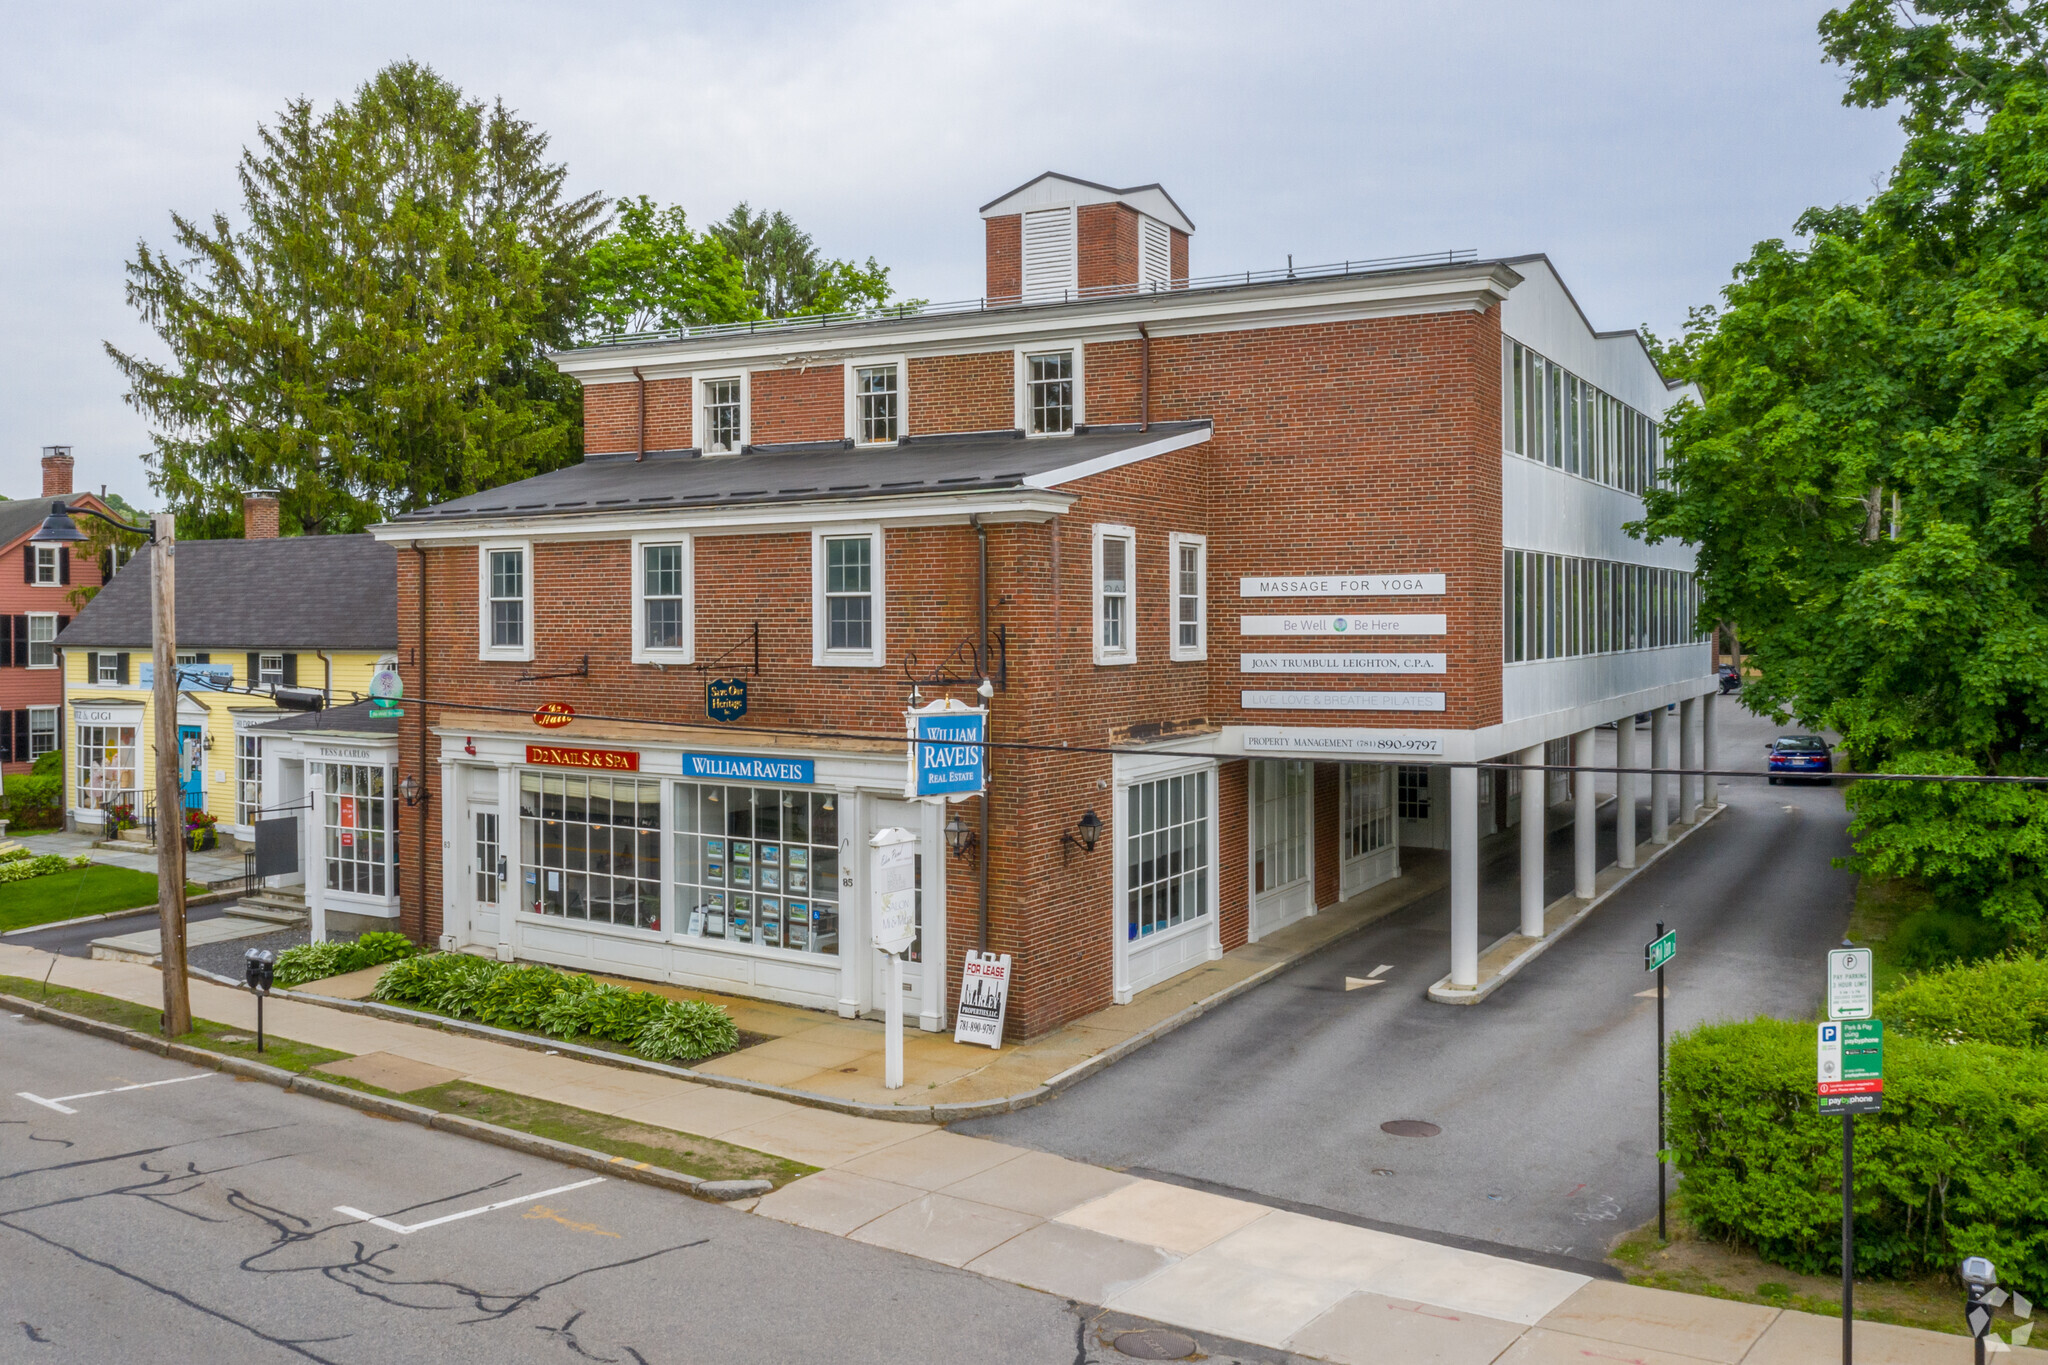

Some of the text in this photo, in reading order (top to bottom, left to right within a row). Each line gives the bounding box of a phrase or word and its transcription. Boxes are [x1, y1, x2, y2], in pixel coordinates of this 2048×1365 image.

[1260, 579, 1424, 592] MASSAGE FOR YOGA
[1284, 619, 1400, 631] Be Well Be Here
[1251, 658, 1435, 669] JOAN TRUMBULL LEIGHTON, C.P.A.
[711, 685, 744, 697] Save Our
[712, 698, 742, 710] Heritage
[1252, 694, 1433, 707] LIVE LOVE & BREATHE PILATES
[90, 711, 111, 721] GIGI
[926, 727, 977, 742] WILLIAM
[1248, 737, 1437, 751] PROPERTY MANAGEMENT (781) 890-9797
[320, 747, 370, 759] TESS & CARLOS
[532, 748, 630, 768] D2 NAILS & SPA
[924, 746, 979, 769] RAVEIS
[692, 757, 803, 780] WILLIAM RAVEIS
[928, 771, 974, 784] REAL ESTATE
[843, 878, 853, 887] 85
[967, 963, 1005, 978] FOR LEASE
[960, 1020, 996, 1036] 781-890-9797
[1844, 1037, 1879, 1045] paybyphone
[1828, 1095, 1873, 1106] paybyphone
